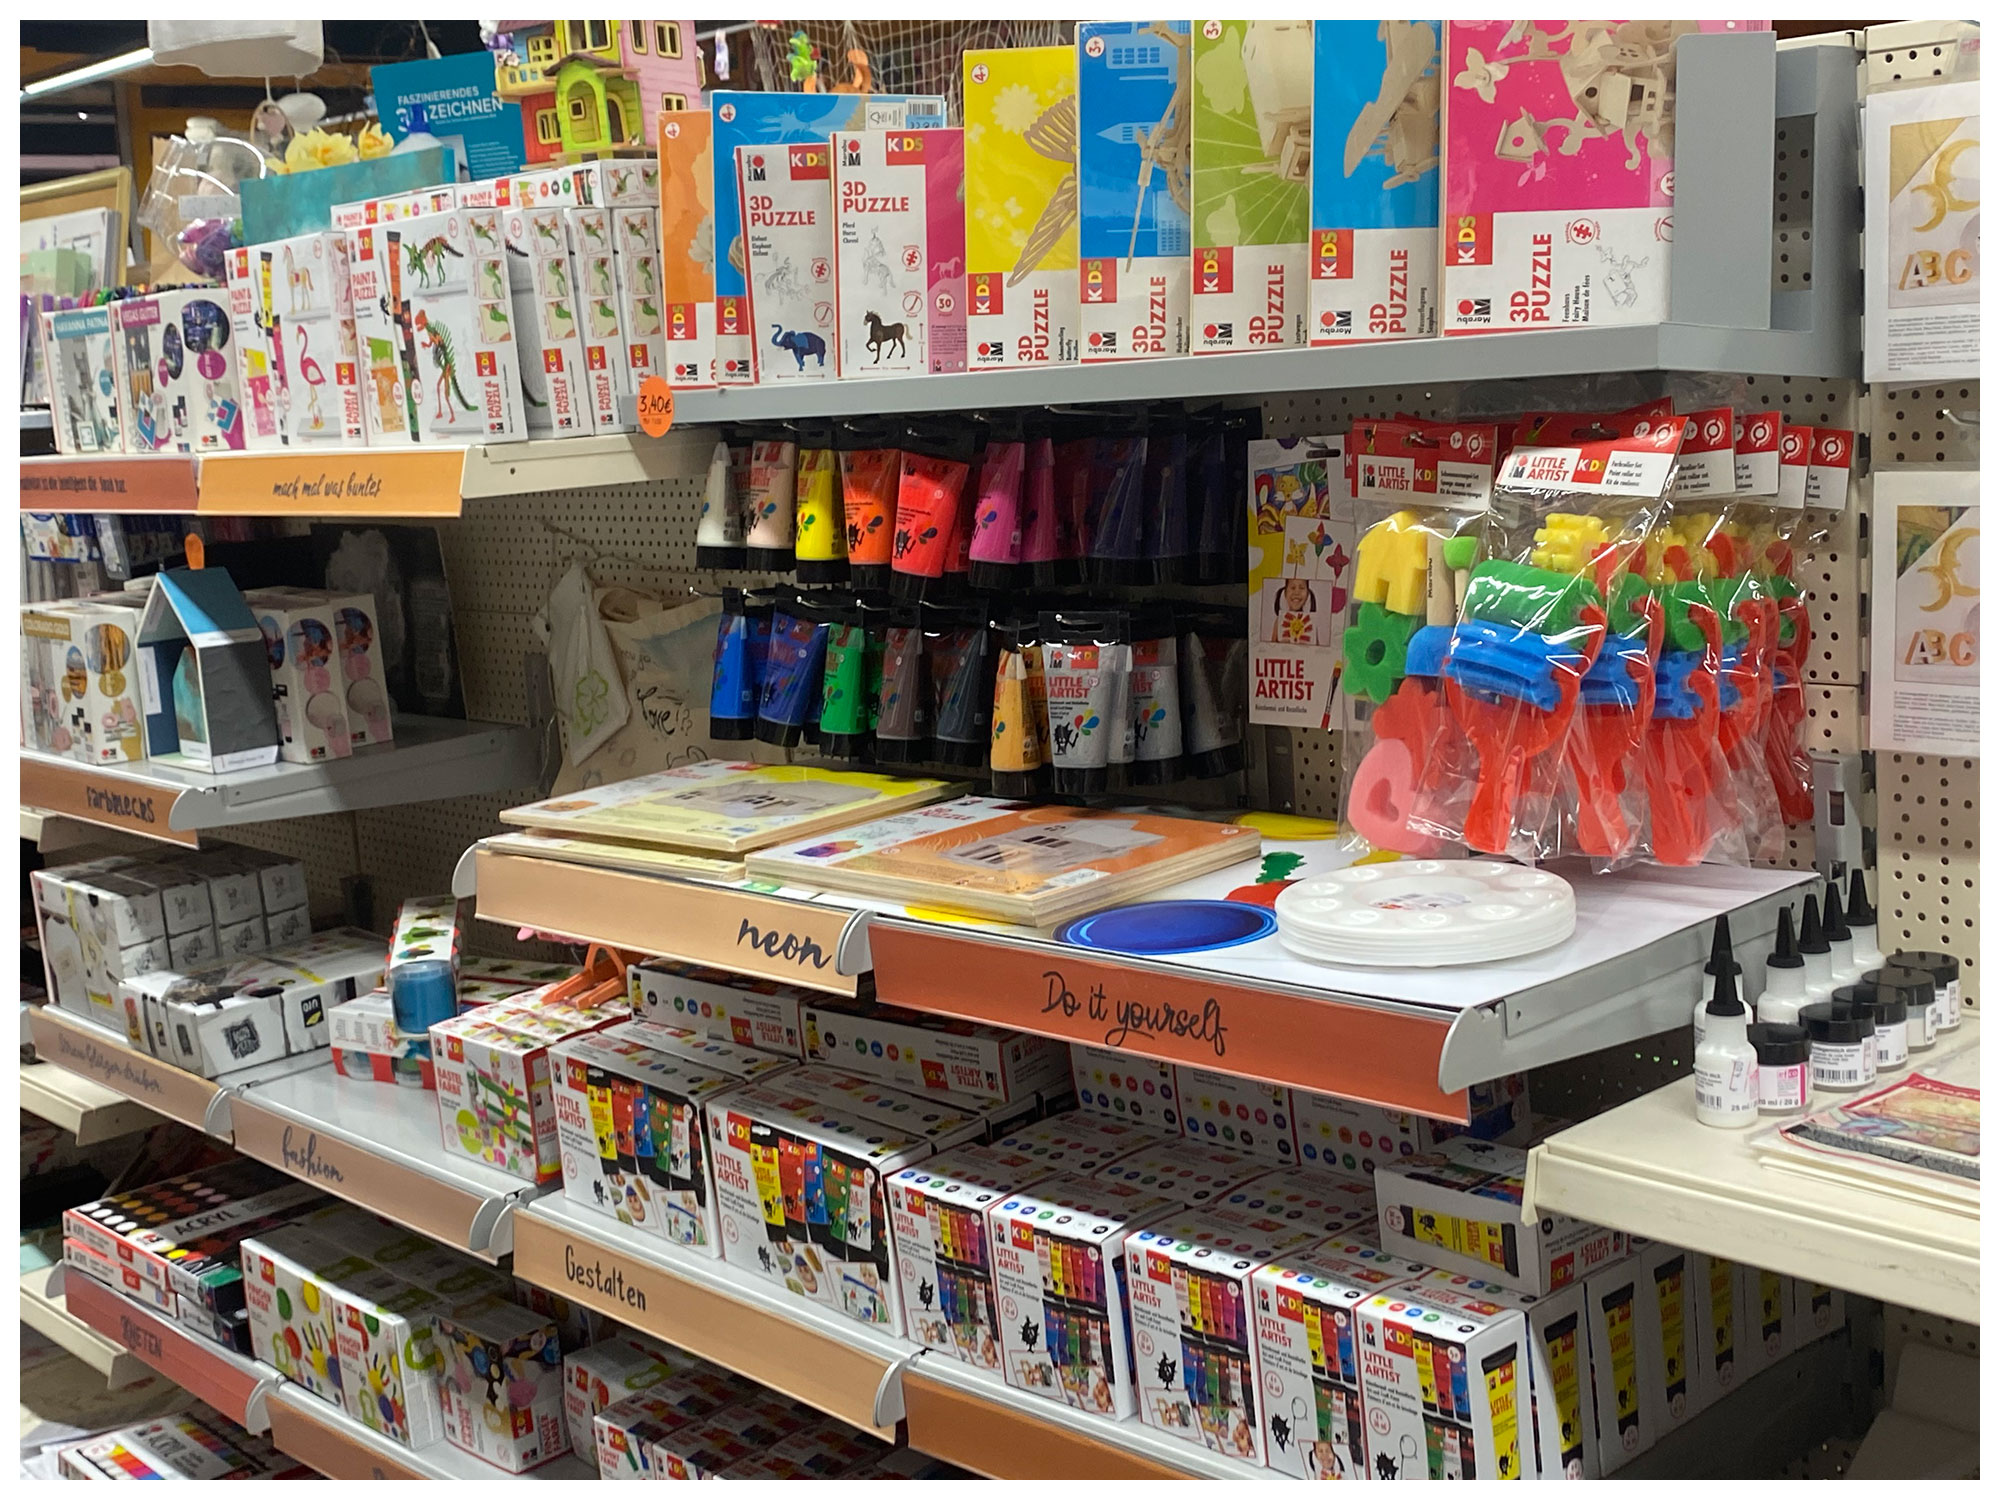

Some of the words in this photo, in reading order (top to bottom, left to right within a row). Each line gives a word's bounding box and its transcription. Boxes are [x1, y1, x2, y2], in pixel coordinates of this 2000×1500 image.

[397, 86, 479, 105] FASZINIERENDES
[429, 97, 503, 119] ZEICHNEN
[888, 137, 923, 152] KIDS
[791, 151, 828, 167] KIDS
[842, 181, 867, 196] 3D
[750, 196, 773, 211] 3D
[843, 197, 909, 213] PUZZLE
[751, 211, 815, 227] PUZZLE
[1458, 216, 1476, 264] KIDS
[1321, 231, 1338, 277] KIDS
[352, 272, 370, 285] PAINT
[1203, 249, 1219, 292] KIDS
[1531, 234, 1552, 322] PUZZLE
[1088, 261, 1102, 302] KIDS
[1389, 250, 1408, 333] PUZZLE
[353, 286, 377, 300] PUZZLE
[976, 275, 990, 314] KIDS
[1268, 265, 1284, 343] PUZZLE
[1510, 290, 1529, 323] 3D
[1150, 277, 1166, 352] PUZZLE
[1369, 304, 1387, 334] 3D
[1034, 289, 1049, 361] PUZZLE
[1249, 316, 1266, 344] 3D
[1018, 335, 1033, 361] 3D
[1132, 325, 1148, 353] 3D
[639, 394, 672, 414] 3,40€
[1378, 466, 1405, 478] LITTLE
[1531, 457, 1566, 469] LITTLE
[273, 475, 300, 499] mach
[302, 473, 326, 497] mal
[324, 480, 344, 498] was
[347, 471, 382, 498] buntes
[1378, 479, 1410, 491] ARTIST
[1527, 470, 1569, 482] ARTIST
[1255, 658, 1304, 679] LITTLE
[1050, 676, 1082, 688] LITTLE
[1255, 679, 1314, 700] ARTIST
[1050, 688, 1090, 698] ARTIST
[737, 918, 833, 969] neon
[1042, 971, 1081, 1016] Do
[1089, 983, 1111, 1022] it
[1105, 999, 1229, 1057] yourself
[951, 1064, 982, 1078] ARTIST
[1778, 1069, 1798, 1078] efco
[957, 1074, 983, 1089] LITTLE
[556, 1093, 580, 1114] LITTLE
[558, 1108, 587, 1131] ARTIST
[282, 1126, 344, 1183] fashion
[715, 1151, 743, 1176] LITTLE
[717, 1168, 750, 1193] ARTIST
[173, 1208, 238, 1236] ACRYL
[894, 1211, 914, 1227] LITTLE
[895, 1221, 920, 1240] ARTIST
[996, 1246, 1020, 1263] LITTLE
[997, 1257, 1026, 1275] ARTIST
[565, 1244, 647, 1313] Gestalten
[1131, 1278, 1156, 1296] LITTLE
[1133, 1291, 1161, 1309] ARTIST
[1260, 1316, 1286, 1335] LITTLE
[1261, 1329, 1292, 1348] ARTIST
[1384, 1326, 1413, 1346] KIDS
[1364, 1351, 1394, 1370] LITTLE
[1365, 1365, 1401, 1385] ARTIST
